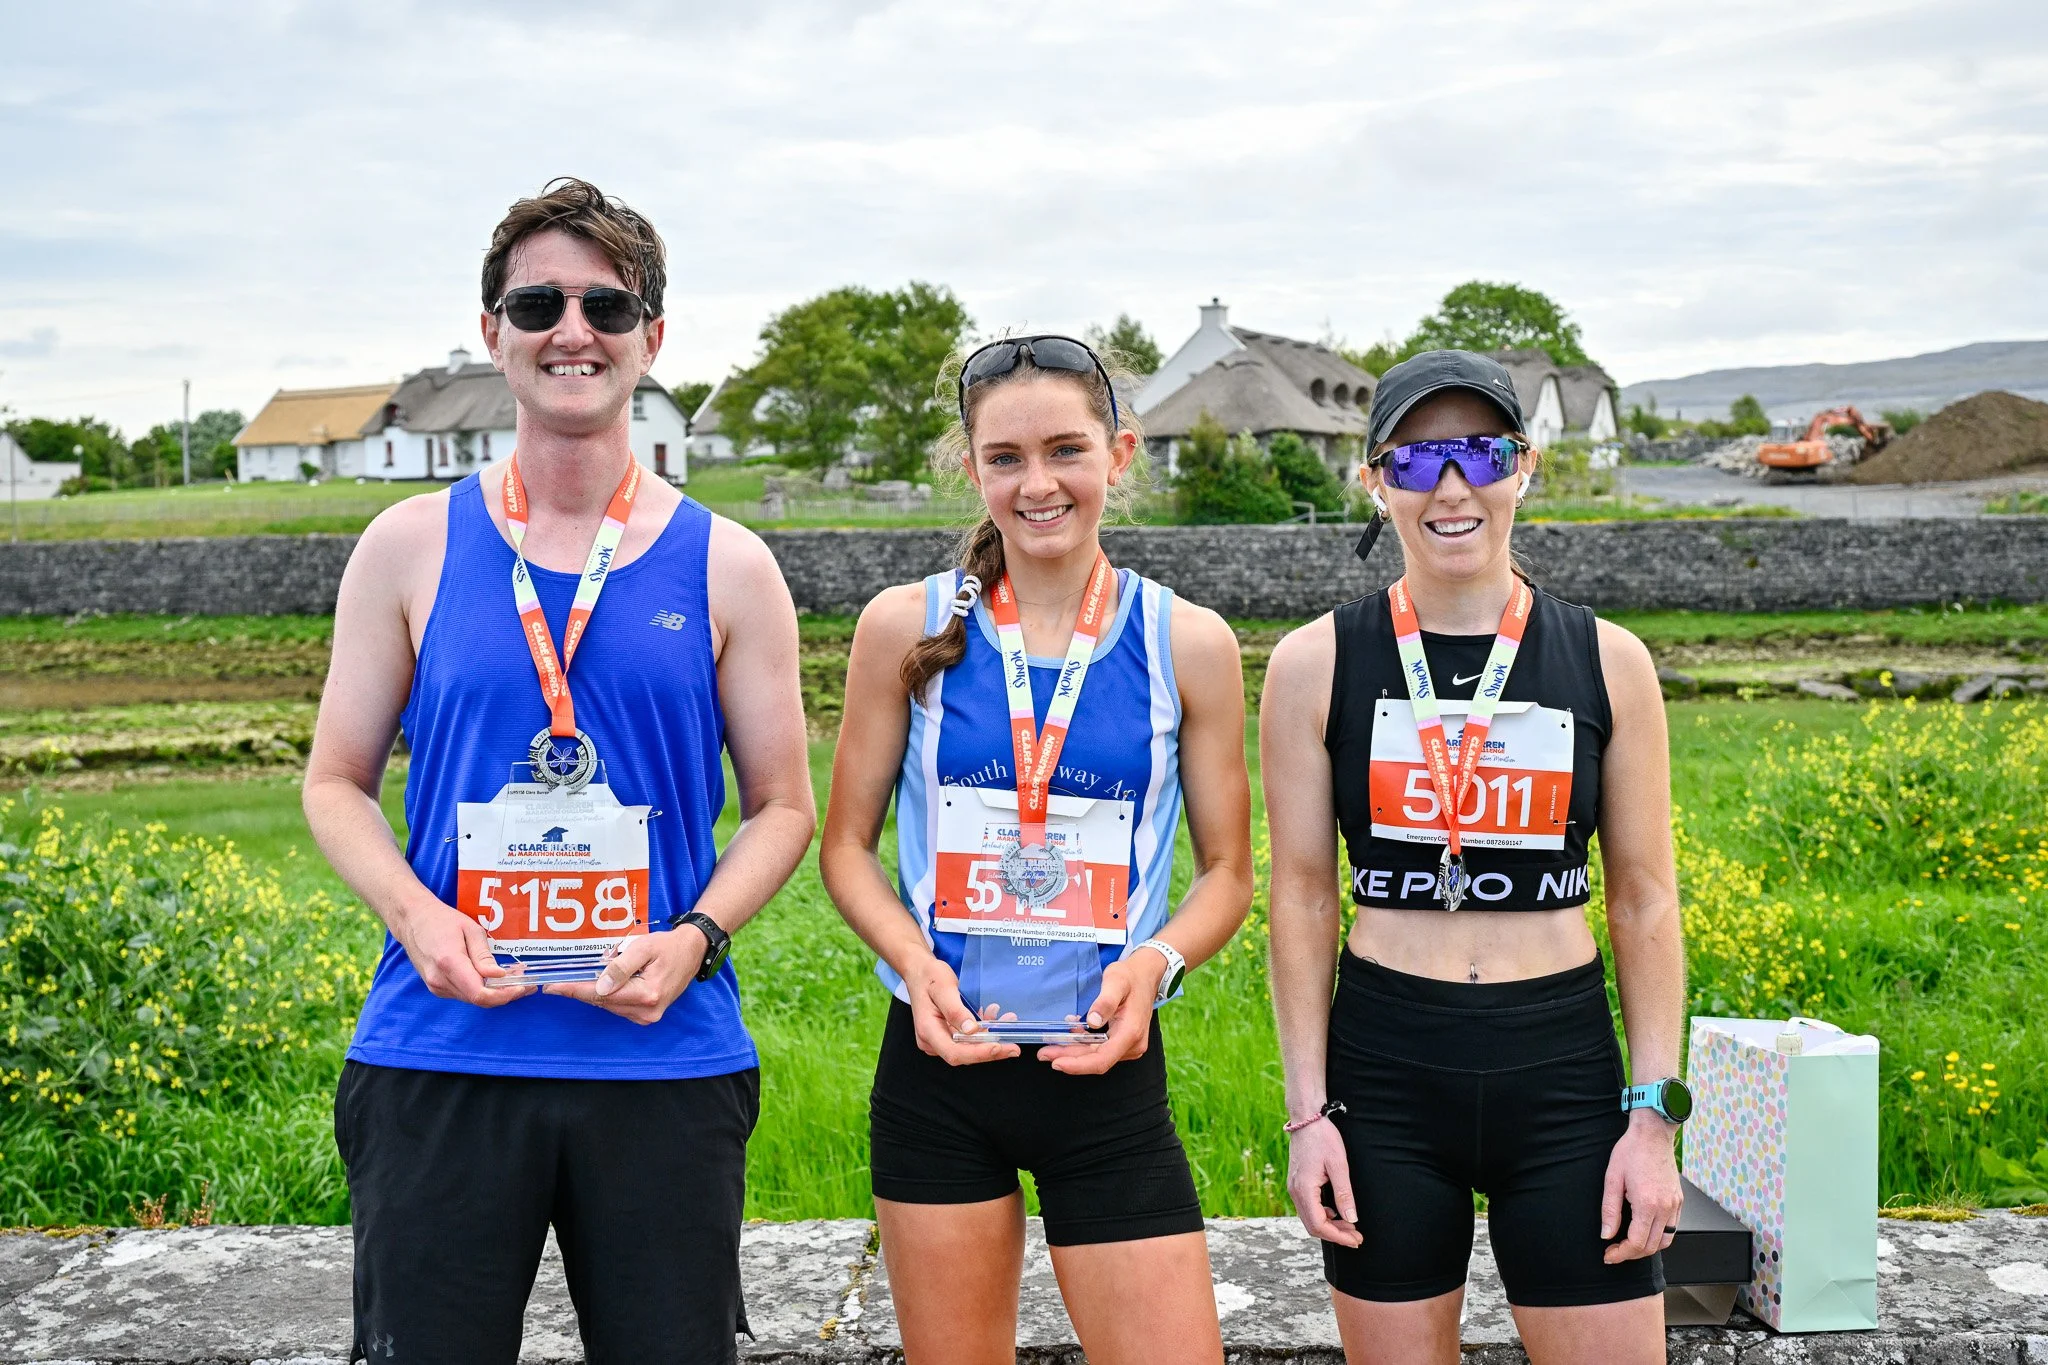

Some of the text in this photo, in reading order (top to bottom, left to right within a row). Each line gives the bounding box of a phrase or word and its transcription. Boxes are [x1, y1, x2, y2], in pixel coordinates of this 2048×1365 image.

[589, 546, 613, 582] MONKS
[1083, 593, 1099, 625] CLARE
[532, 622, 559, 697] CLARE BURREN
[1010, 649, 1026, 688] MONKS
[1058, 660, 1082, 698] MONKS
[1411, 659, 1430, 699] MONKS
[1483, 662, 1508, 698] MONKS
[1021, 729, 1033, 765] CLARE
[1464, 736, 1480, 770] CLARE
[1483, 741, 1506, 749] REN
[1029, 733, 1056, 810] CLARE BURREN
[1054, 765, 1101, 791] way
[1431, 738, 1454, 815] CLARE BURREN
[1402, 768, 1533, 828] 5011
[997, 828, 1067, 841] CLAR REN
[1407, 833, 1438, 842] Emergency
[1486, 838, 1522, 846] 0872691147
[1352, 866, 1393, 898] KE
[1536, 866, 1590, 901] NIK
[477, 876, 635, 933] 5158
[1010, 936, 1052, 947] Winner
[1017, 955, 1045, 966] 2026
